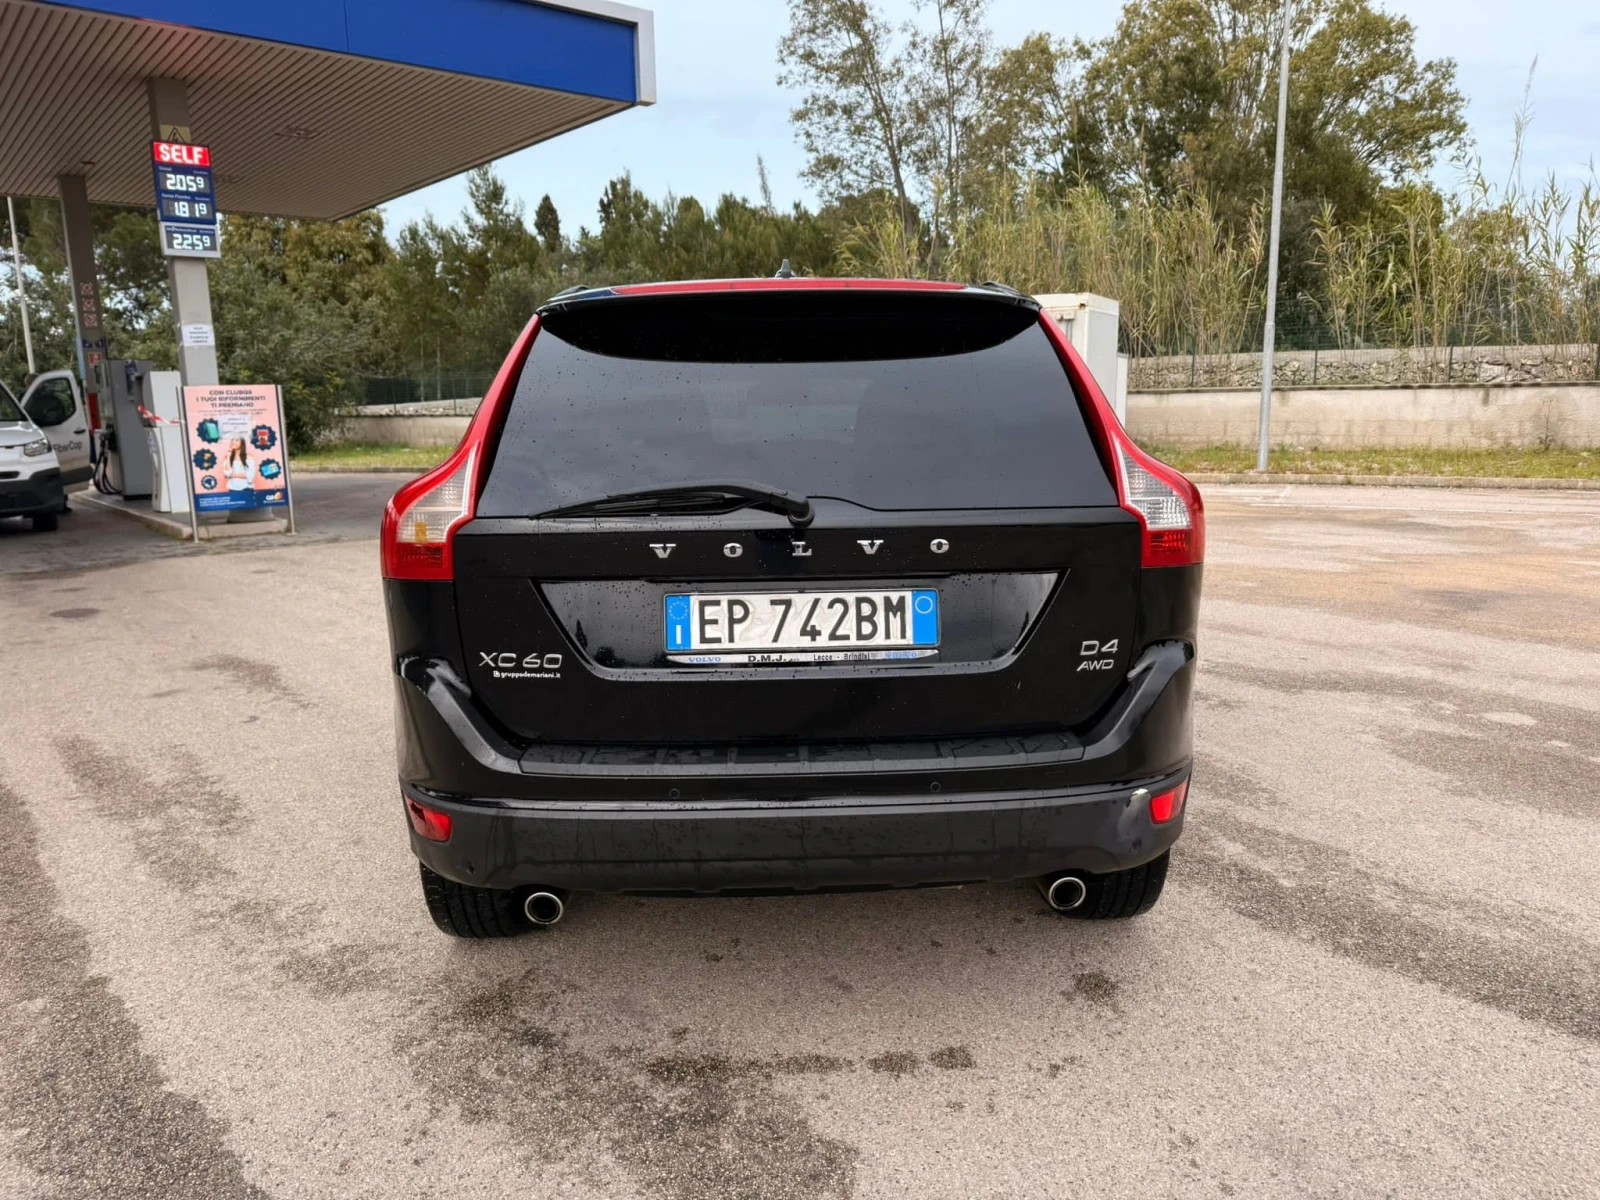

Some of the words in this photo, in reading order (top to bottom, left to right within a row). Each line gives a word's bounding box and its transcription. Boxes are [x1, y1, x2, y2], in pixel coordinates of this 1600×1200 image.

[159, 144, 204, 165] SELF
[649, 538, 950, 559] VOLVO
[699, 599, 750, 644] EP
[813, 653, 833, 661] Lecce
[1080, 639, 1119, 656] D4
[1076, 659, 1115, 672] AWD
